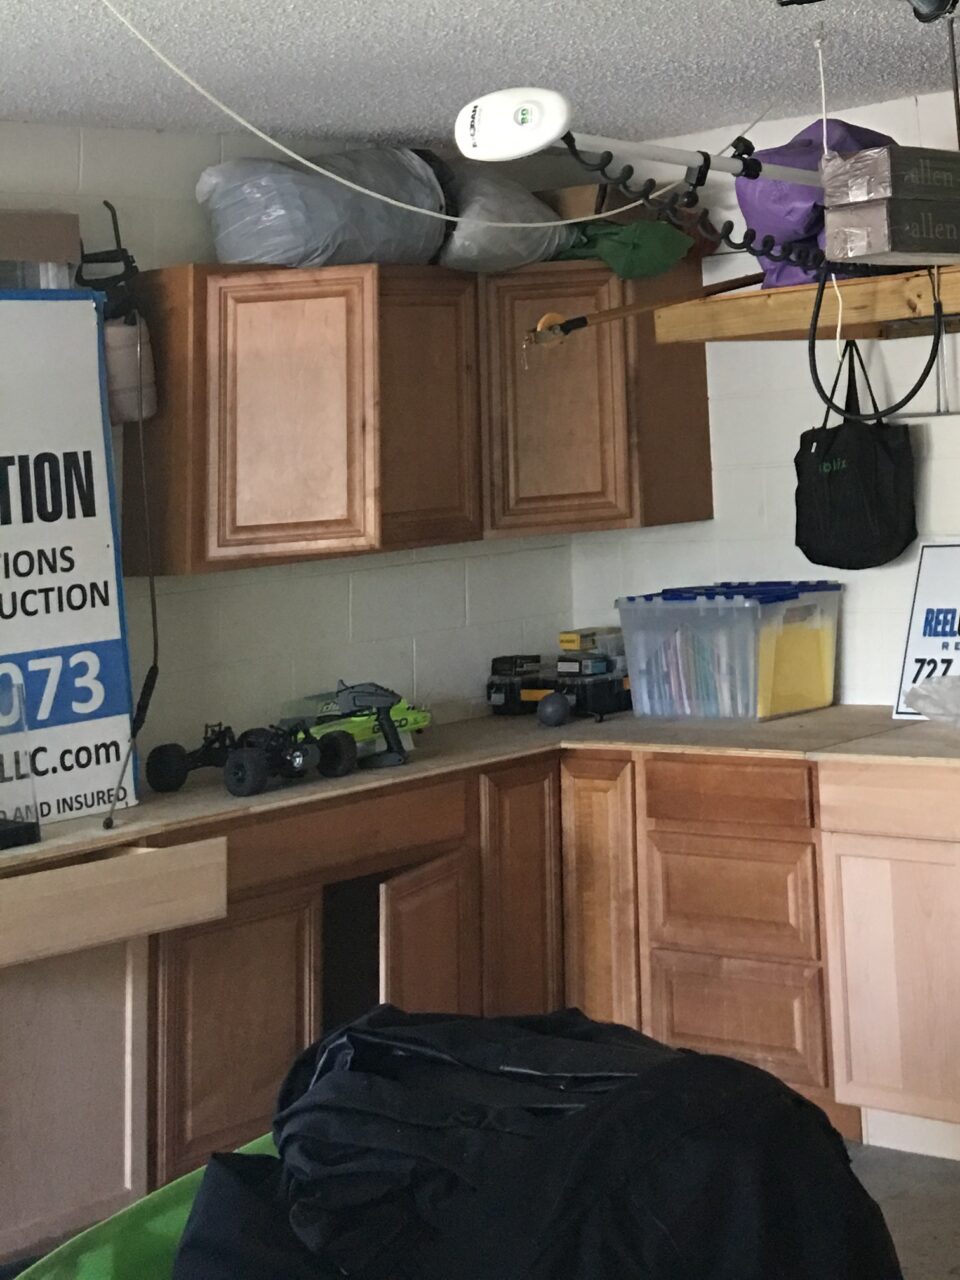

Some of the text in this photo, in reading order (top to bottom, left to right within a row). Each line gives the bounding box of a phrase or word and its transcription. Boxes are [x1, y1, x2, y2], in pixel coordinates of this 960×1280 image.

[911, 158, 954, 187] allen
[911, 212, 958, 239] allen
[0, 546, 75, 579] IONS
[56, 785, 128, 815] INSURED
